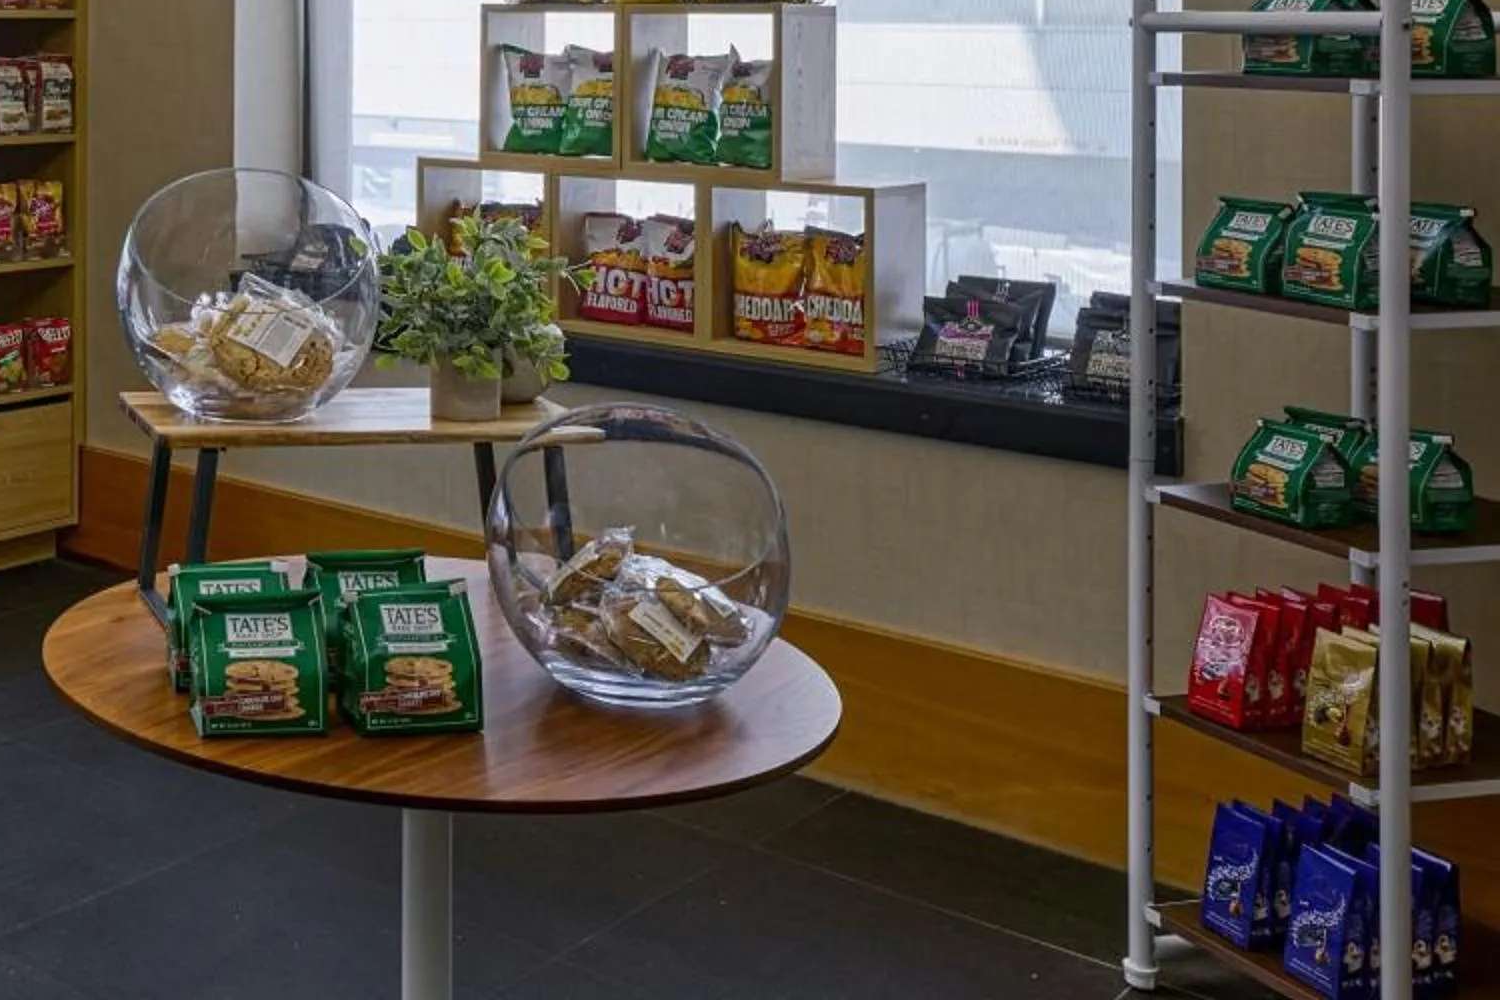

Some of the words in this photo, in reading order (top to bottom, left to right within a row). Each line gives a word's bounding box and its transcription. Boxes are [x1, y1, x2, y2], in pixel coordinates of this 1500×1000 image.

[591, 266, 651, 299] HOT
[735, 294, 793, 323] HEDDAR
[807, 295, 864, 325] CHEDDA
[342, 573, 397, 590] TATE'S
[228, 617, 289, 633] TATE'S
[384, 607, 439, 625] TATE'S
